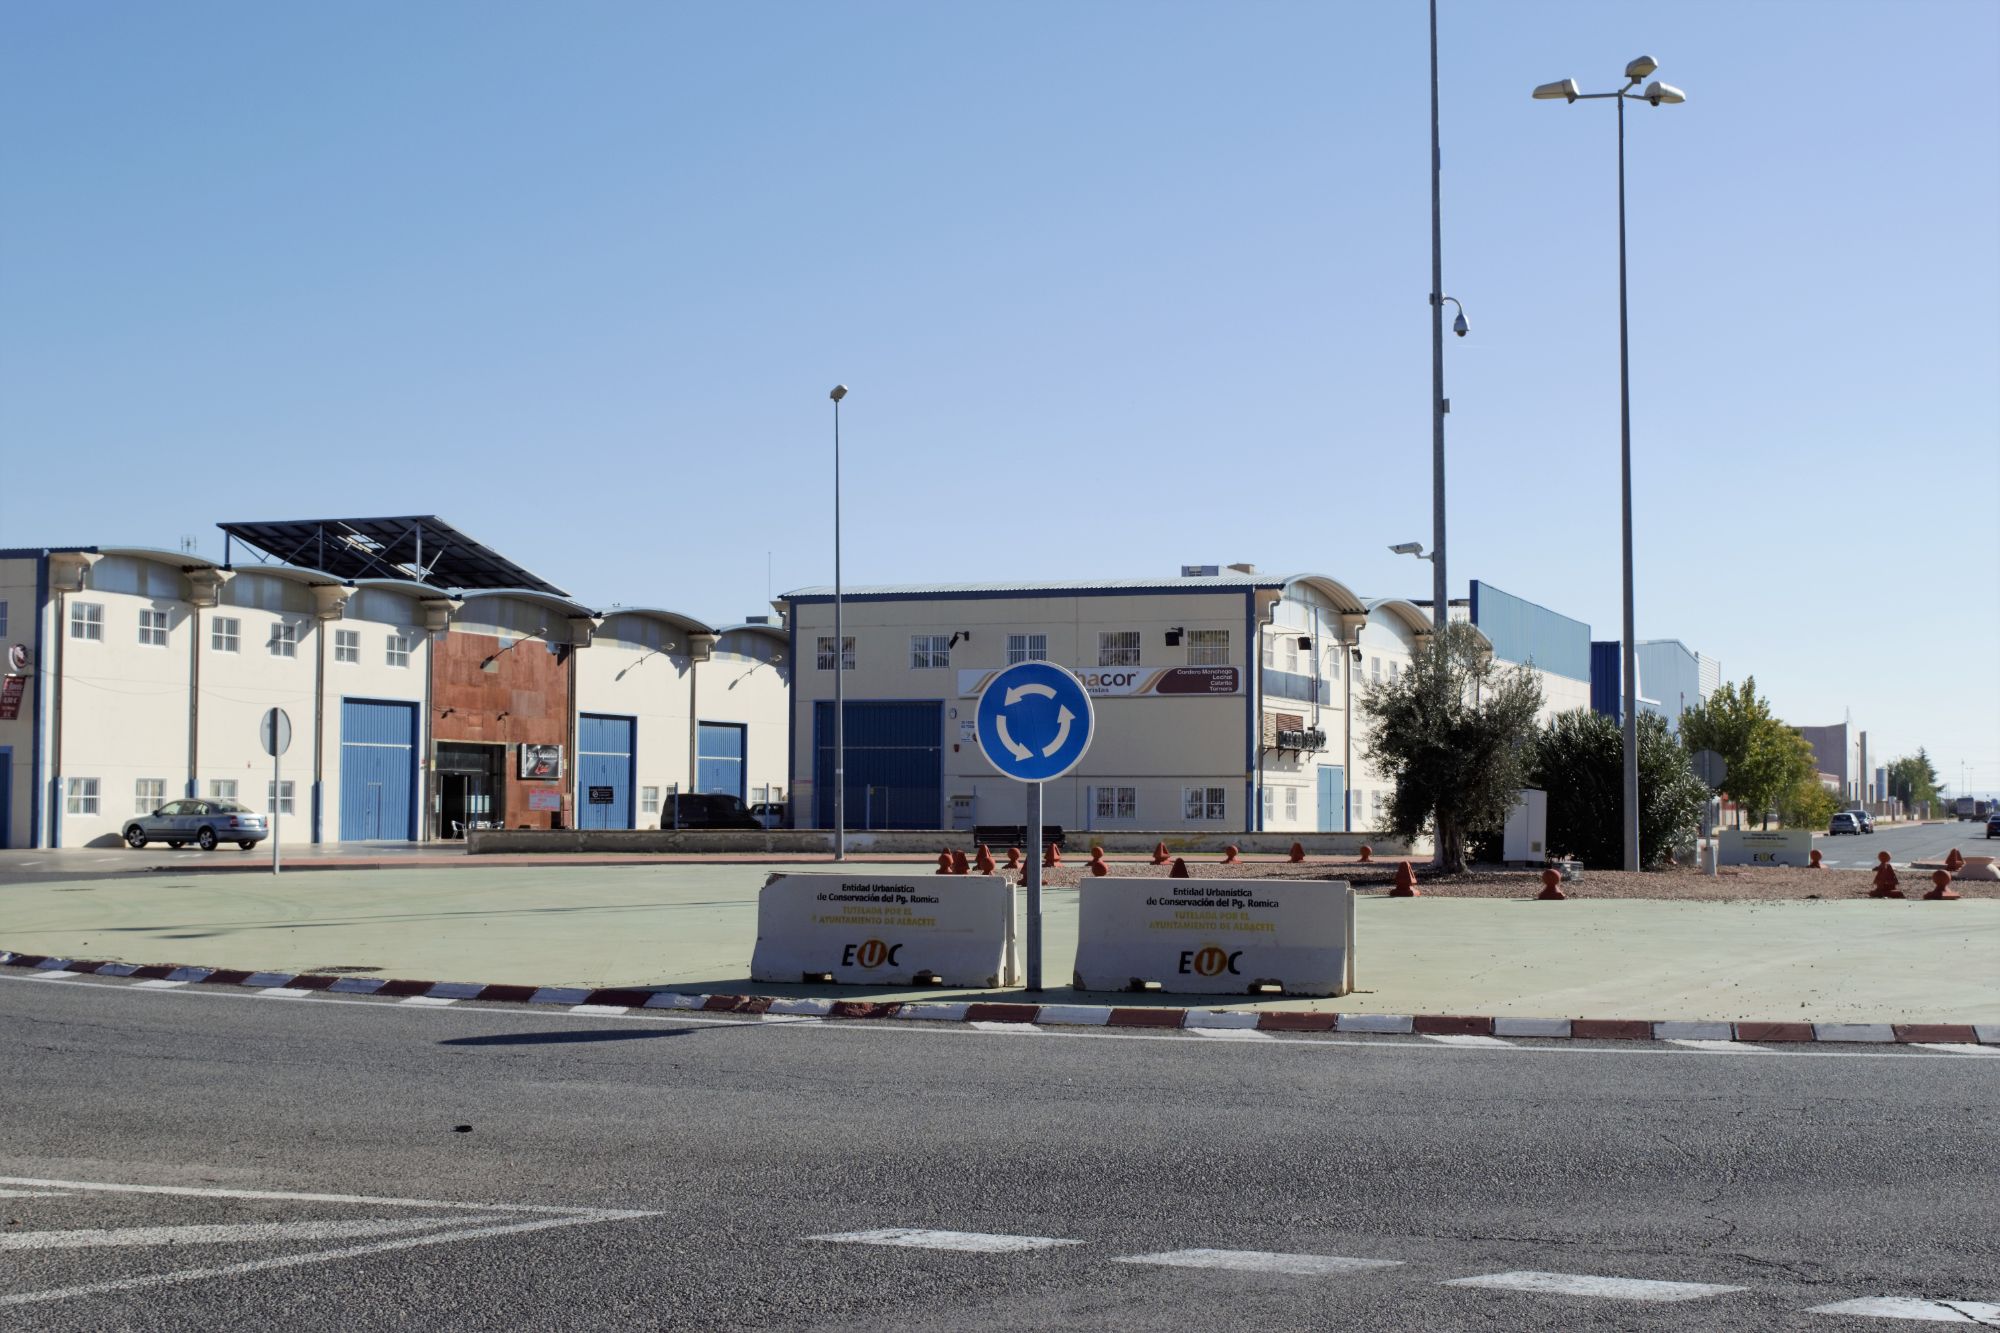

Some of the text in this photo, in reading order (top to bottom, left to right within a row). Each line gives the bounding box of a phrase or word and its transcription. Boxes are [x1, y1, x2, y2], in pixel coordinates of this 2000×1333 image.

[841, 883, 915, 894] Entidad Urbanística
[1173, 887, 1253, 898] Entidad Urbanística
[816, 893, 827, 901] de
[828, 893, 880, 903] Conservación
[880, 894, 894, 903] del
[910, 895, 940, 904] Romica
[1146, 897, 1158, 906] de
[1159, 897, 1215, 907] Conservación
[1216, 898, 1230, 907] del
[1248, 898, 1279, 908] Romica
[841, 939, 903, 969] EUC
[1178, 947, 1244, 976] EUC
